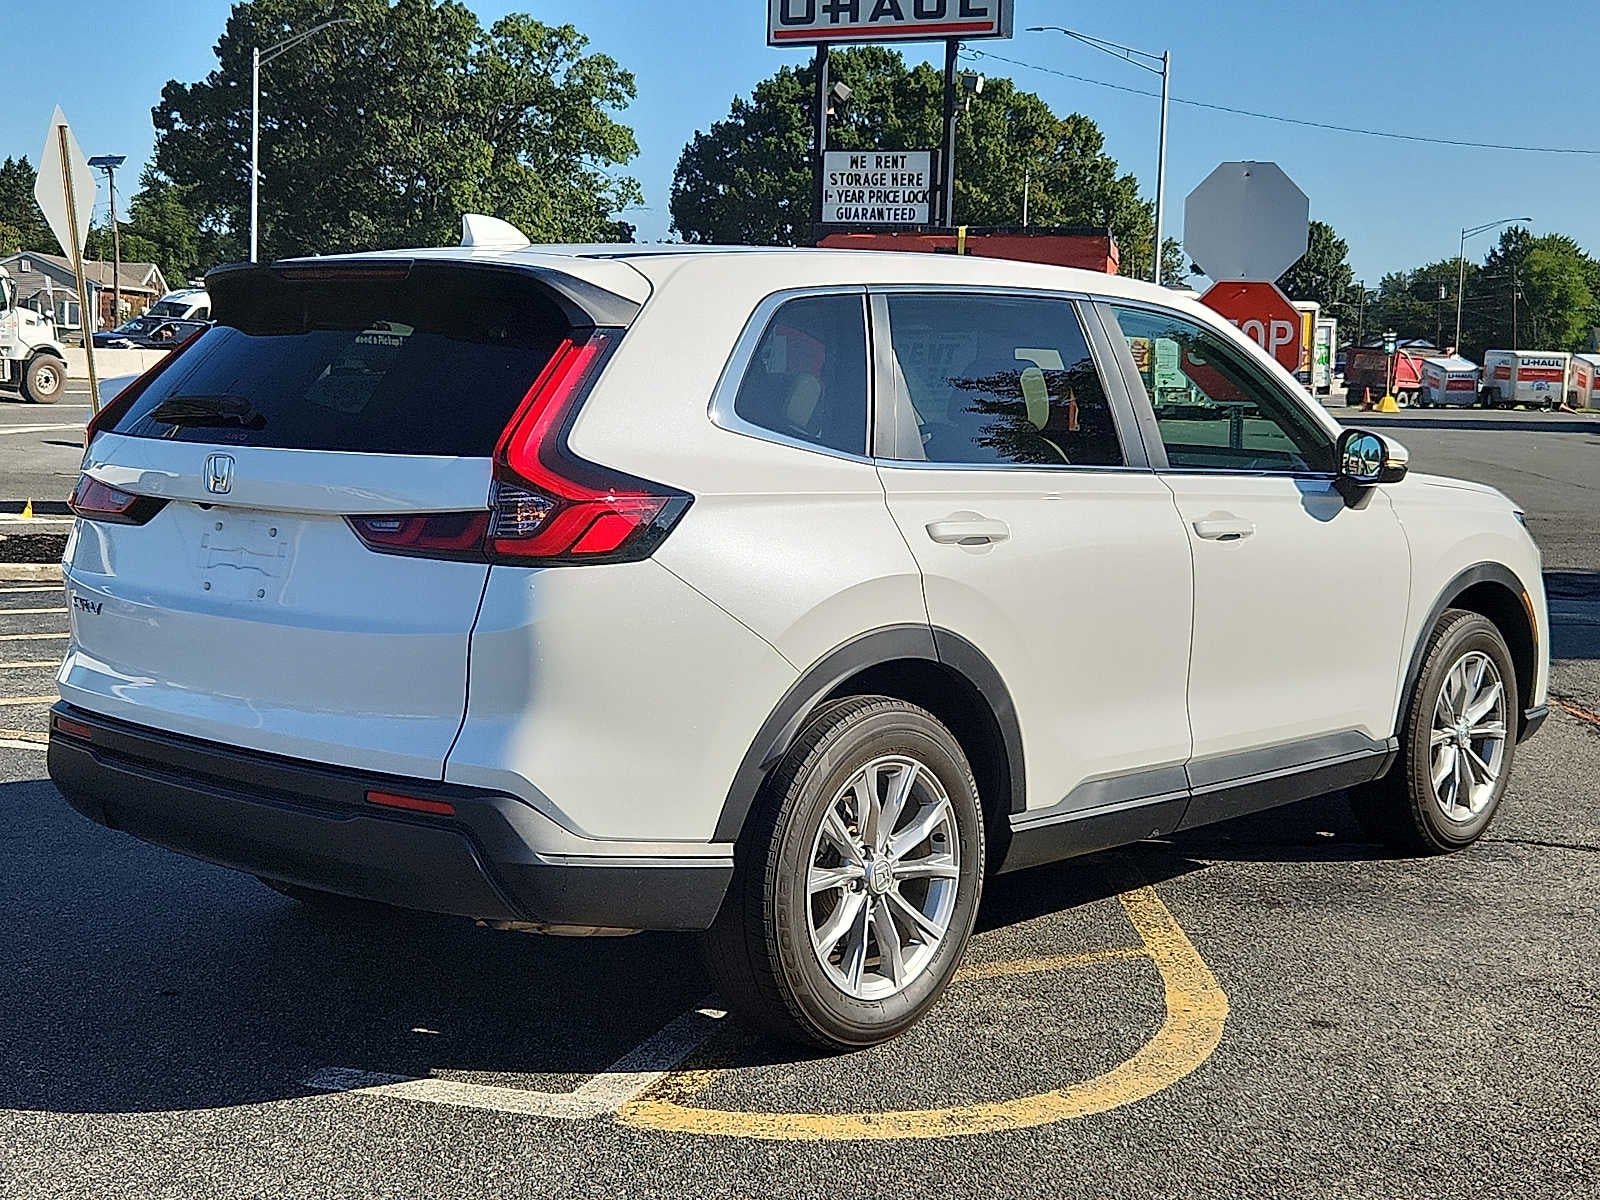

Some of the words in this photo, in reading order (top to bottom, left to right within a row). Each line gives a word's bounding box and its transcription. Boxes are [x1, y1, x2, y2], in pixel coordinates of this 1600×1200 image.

[780, 0, 988, 25] U-HAUL
[850, 156, 867, 169] WE
[876, 155, 907, 169] RENT
[830, 172, 886, 187] STORAGE
[891, 172, 923, 187] HERE
[836, 190, 866, 204] YEAR
[868, 190, 901, 204] PRICE
[902, 189, 929, 204] LOCK
[836, 207, 916, 221] GUARANTEED
[1521, 359, 1562, 367] U-HAUL
